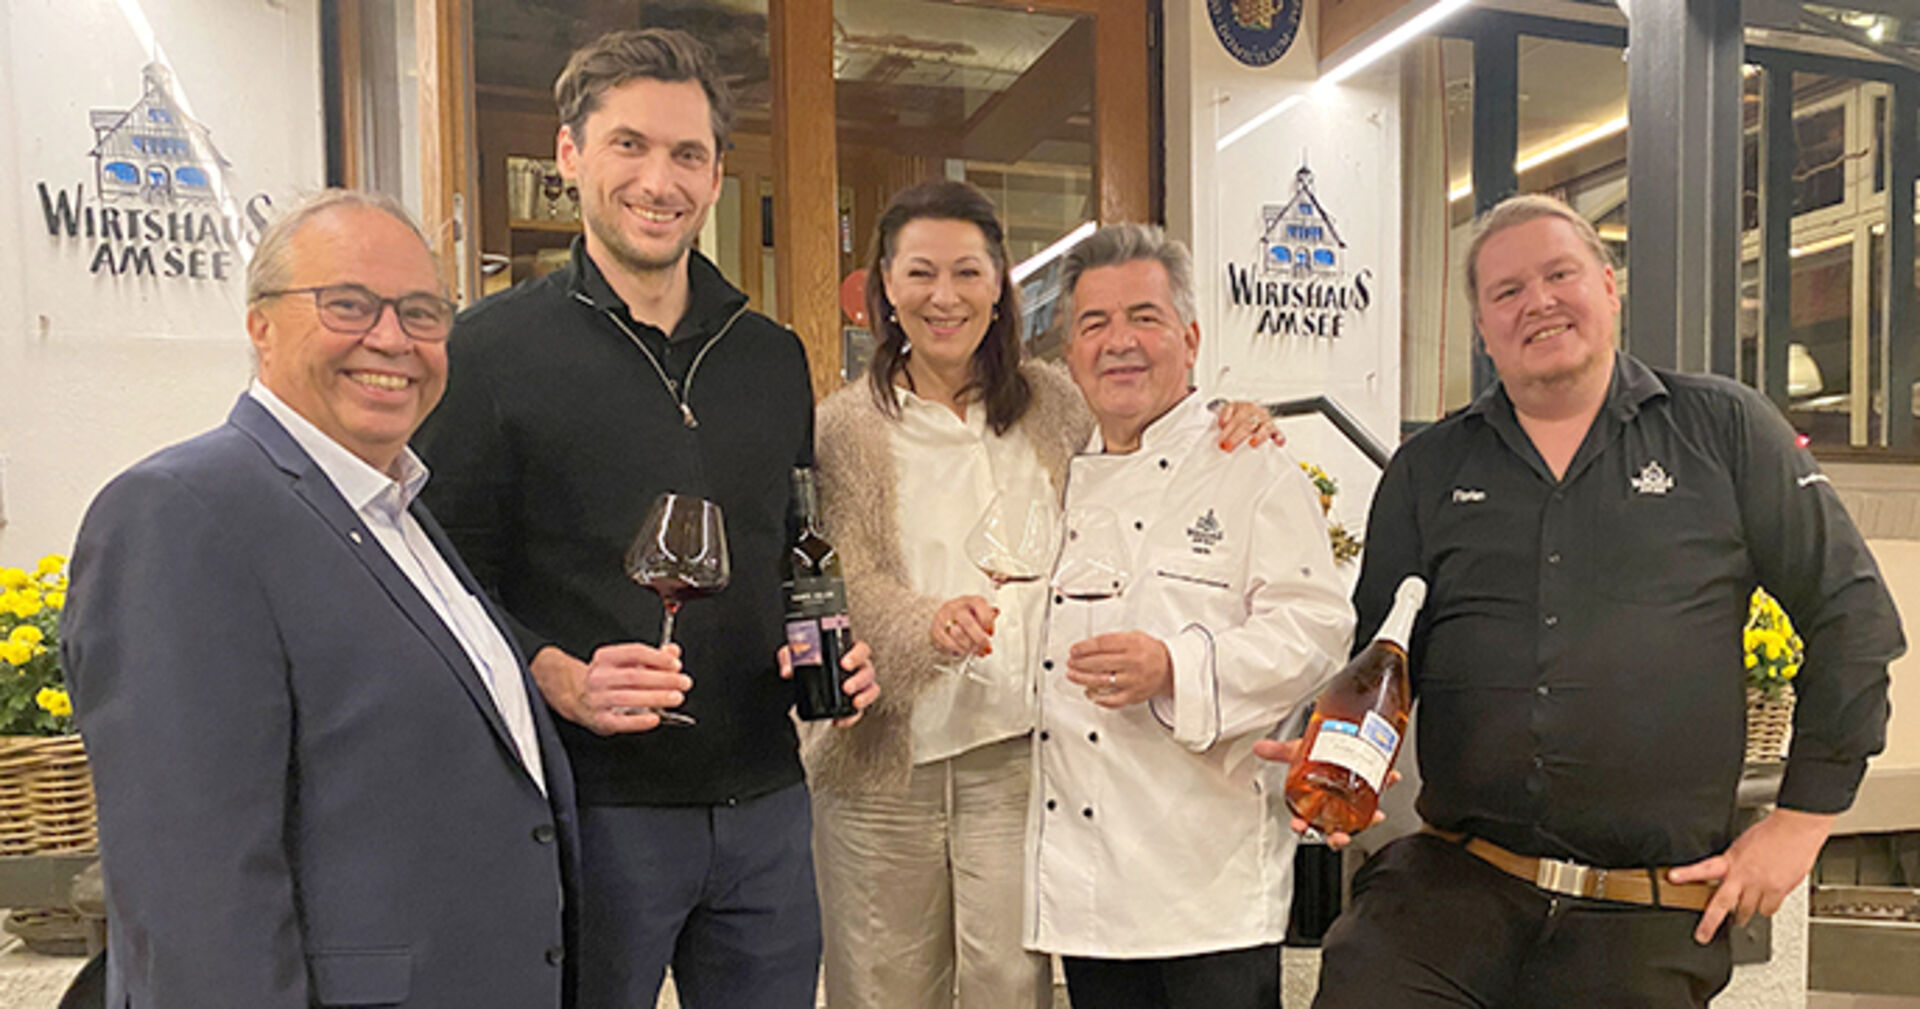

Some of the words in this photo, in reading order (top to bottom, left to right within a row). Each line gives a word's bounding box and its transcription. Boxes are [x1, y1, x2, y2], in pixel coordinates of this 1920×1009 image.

[37, 181, 272, 248] WIRTSHAUS
[89, 242, 156, 277] AM
[163, 246, 232, 281] SEE
[1228, 261, 1373, 312] WIRTSHAUS
[1257, 309, 1298, 335] AM
[1302, 312, 1345, 337] SEE
